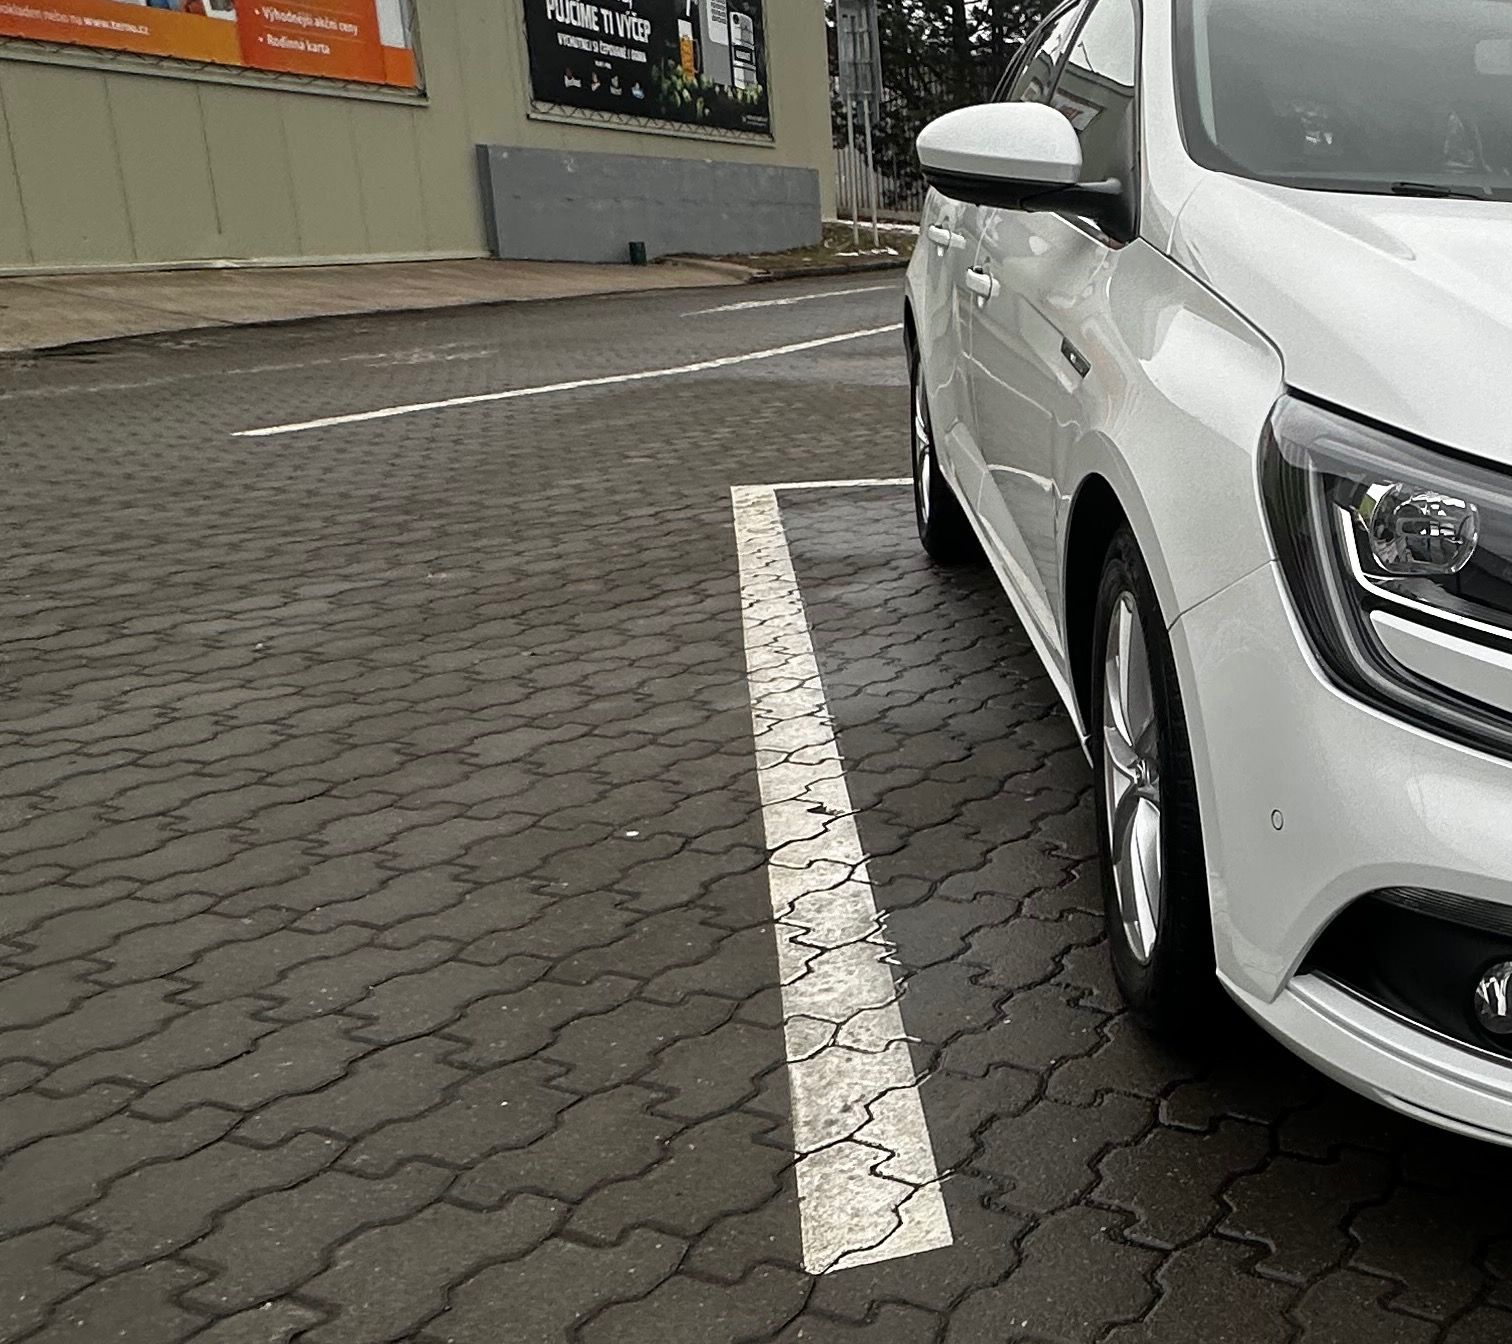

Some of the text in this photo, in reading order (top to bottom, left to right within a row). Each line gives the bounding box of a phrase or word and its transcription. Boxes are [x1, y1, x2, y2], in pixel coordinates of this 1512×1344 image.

[600, 8, 614, 35] TI
[615, 10, 651, 43] VÝČEP
[306, 39, 330, 54] karta
